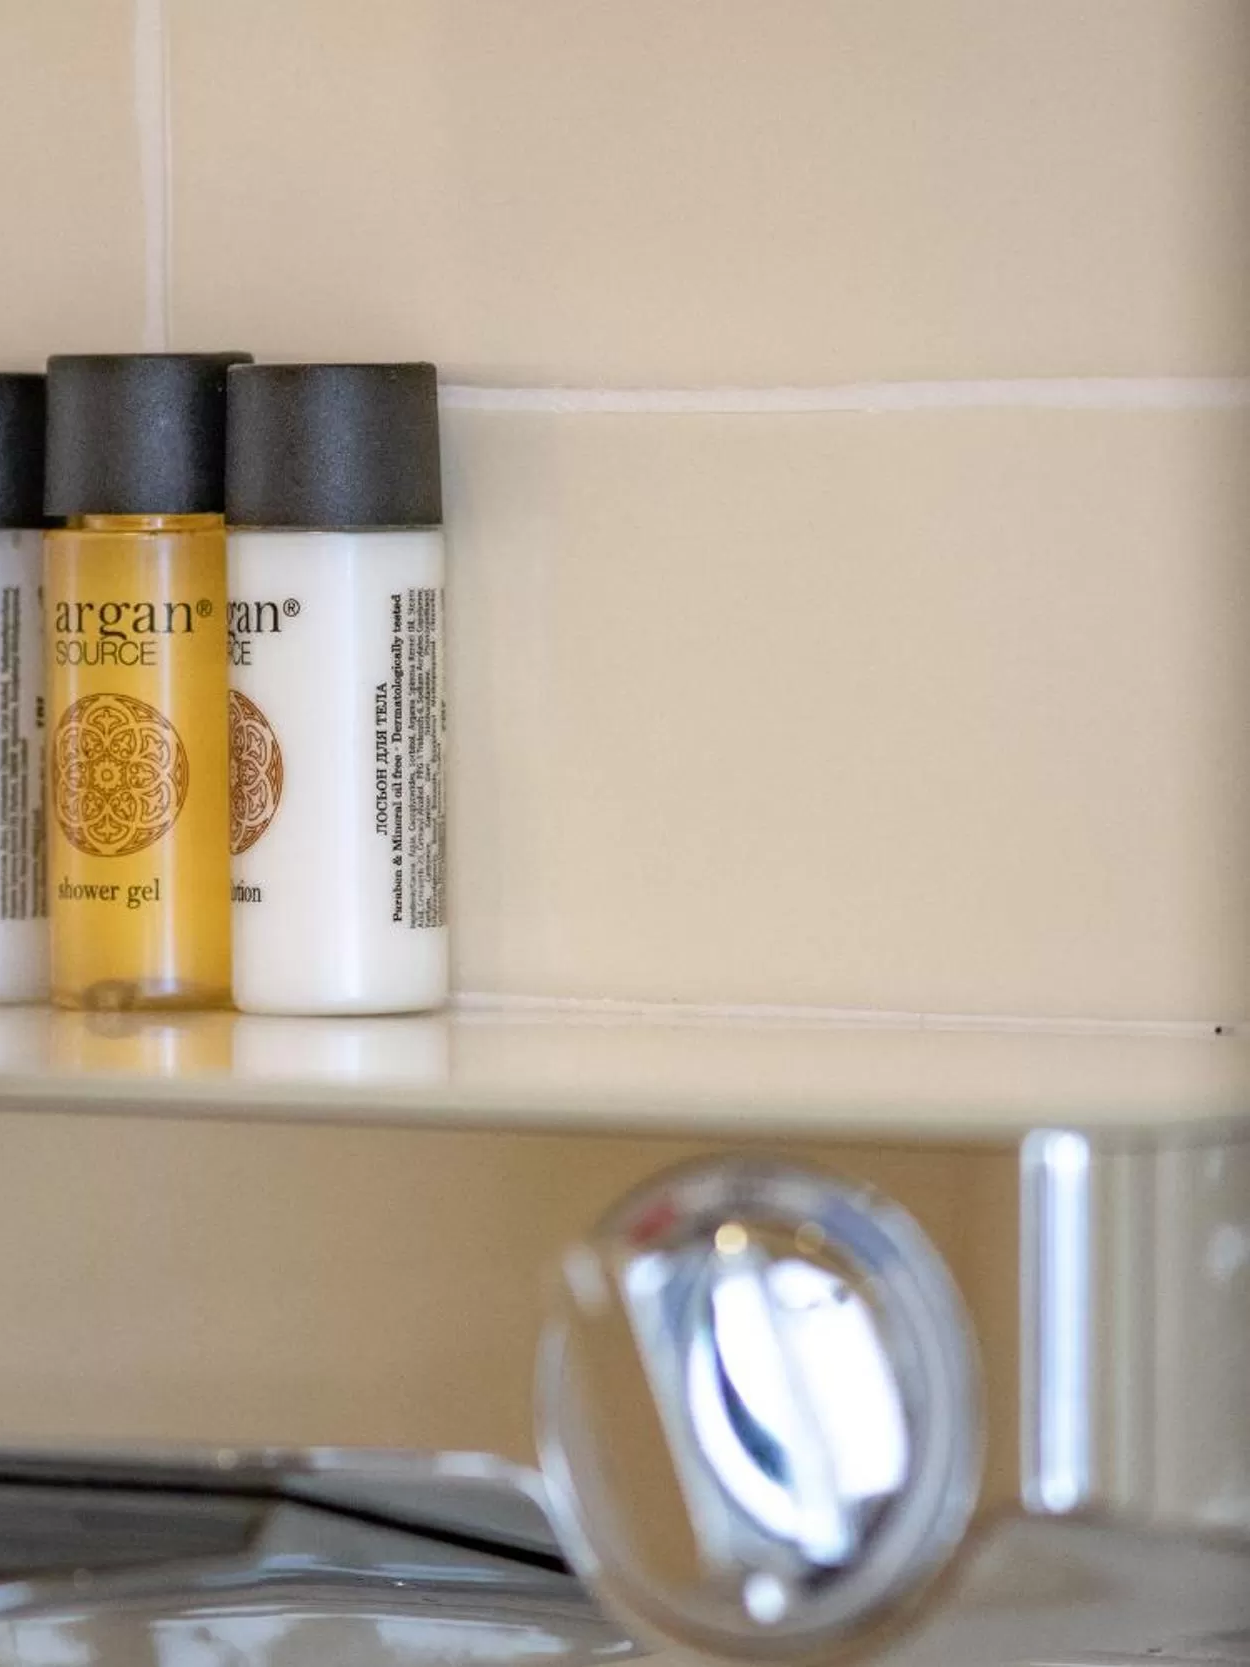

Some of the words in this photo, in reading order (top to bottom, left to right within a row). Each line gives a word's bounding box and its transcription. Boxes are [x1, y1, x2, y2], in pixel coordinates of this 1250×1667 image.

[390, 594, 402, 635] tested
[55, 641, 157, 666] SOURCE
[374, 681, 388, 727] ТЕЛА
[390, 636, 405, 744] Dermatologically
[375, 729, 390, 765] ДЛЯ
[391, 754, 402, 781] free
[375, 768, 388, 836] ЛОСЬОН
[391, 782, 402, 799] oil
[391, 801, 403, 852] Mineral
[392, 854, 403, 868] &
[57, 876, 120, 901] shower
[127, 878, 160, 909] gel
[392, 869, 403, 922] Paraben
